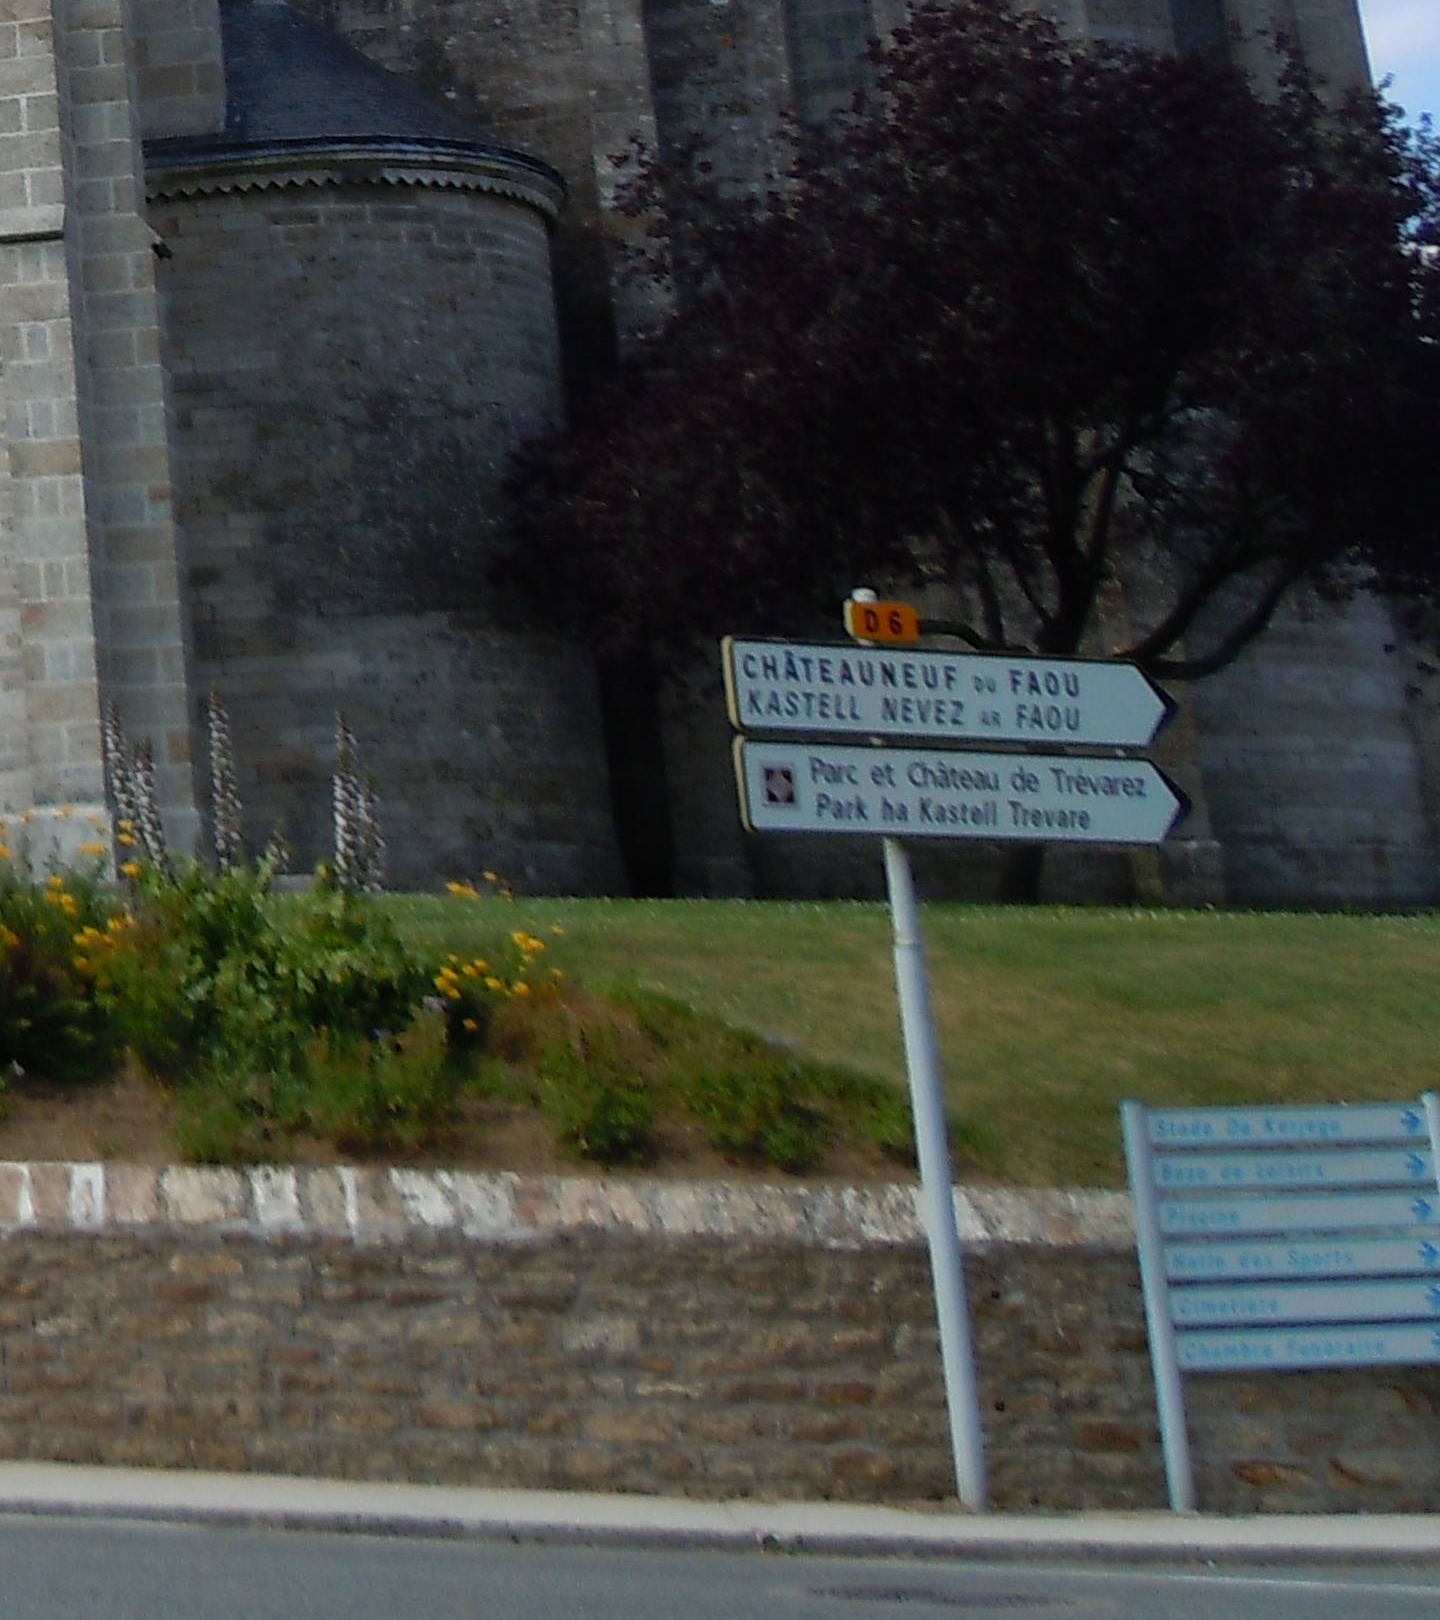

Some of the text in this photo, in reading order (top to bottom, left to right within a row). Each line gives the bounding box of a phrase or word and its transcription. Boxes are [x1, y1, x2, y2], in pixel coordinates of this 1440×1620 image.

[864, 607, 903, 635] D 6
[742, 650, 1080, 698] CHÂTEAUNEUF DU FAOU
[747, 689, 863, 721] KASTELL
[881, 697, 965, 727] NEVEZ
[1015, 703, 1080, 731] FAOU
[809, 756, 1148, 798] Parc et Château de Trévarez
[816, 792, 1091, 830] Park ha Kastell Trevare
[1157, 1118, 1212, 1136] Stade
